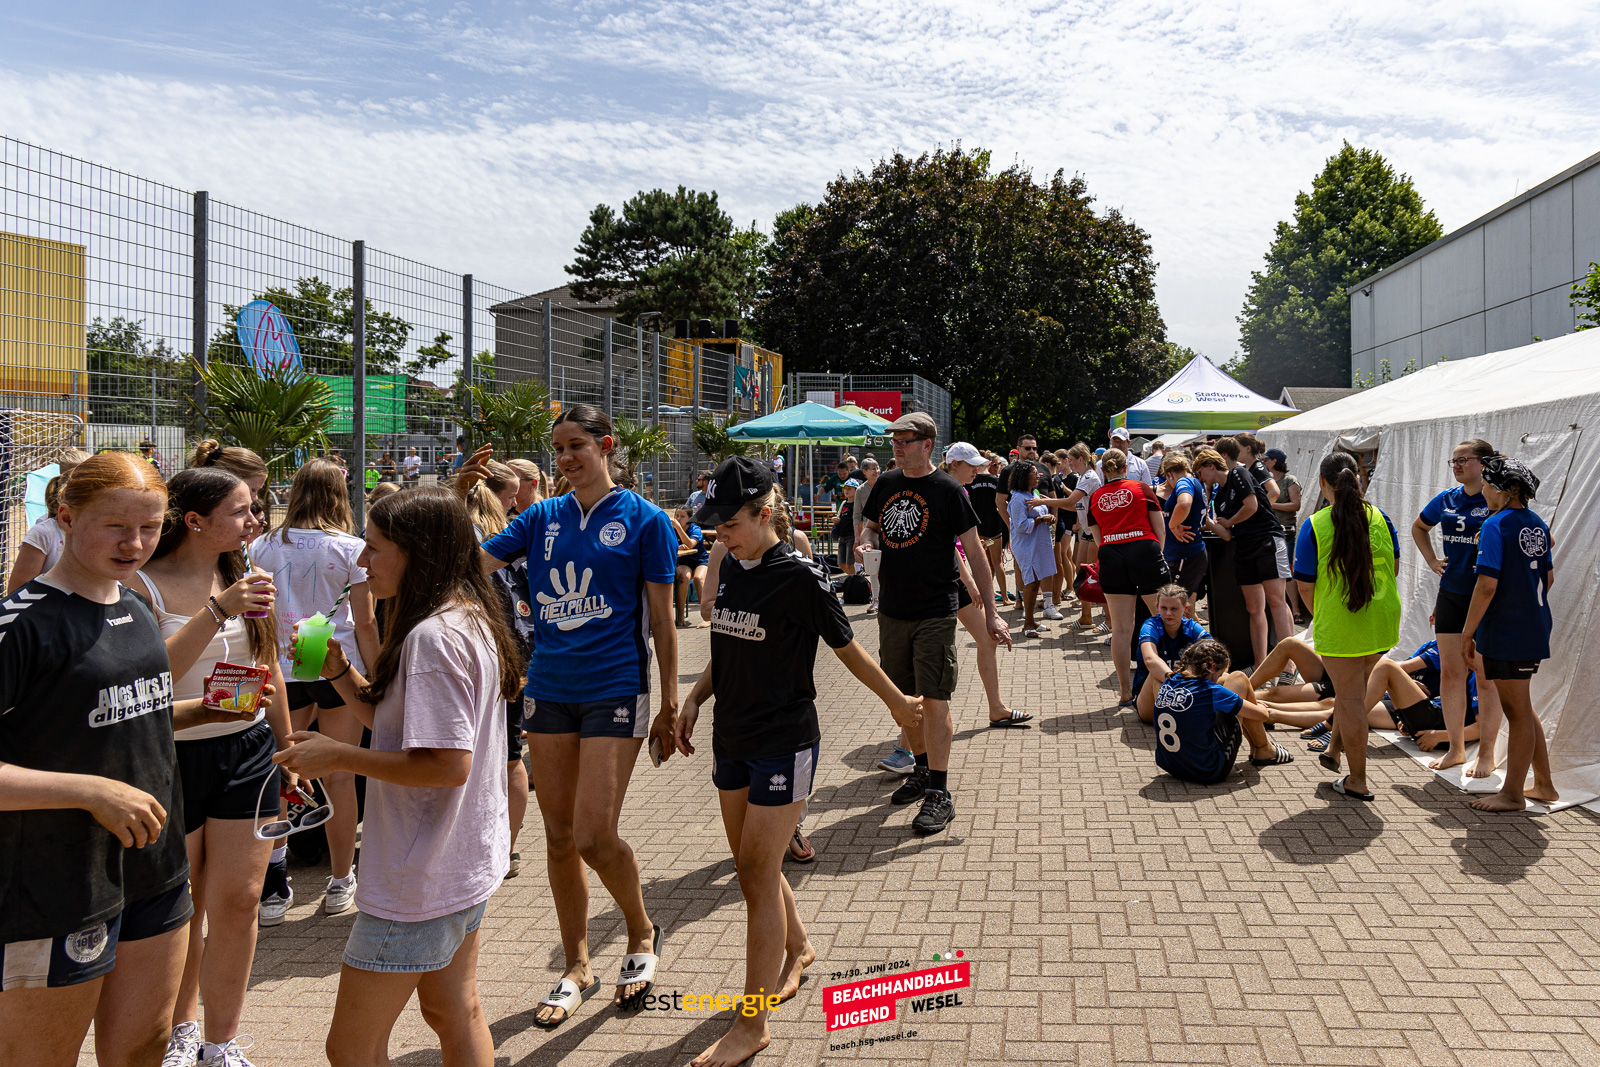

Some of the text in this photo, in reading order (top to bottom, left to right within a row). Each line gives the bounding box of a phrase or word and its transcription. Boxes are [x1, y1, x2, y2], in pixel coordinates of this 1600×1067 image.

[868, 406, 893, 415] Court
[1455, 515, 1467, 532] 3
[544, 536, 555, 562] 9
[900, 535, 920, 549] HOSEN
[276, 561, 317, 603] 11
[737, 610, 760, 628] TEAM
[98, 685, 133, 710] Alles
[134, 676, 160, 698] fürs
[1157, 712, 1181, 753] 8
